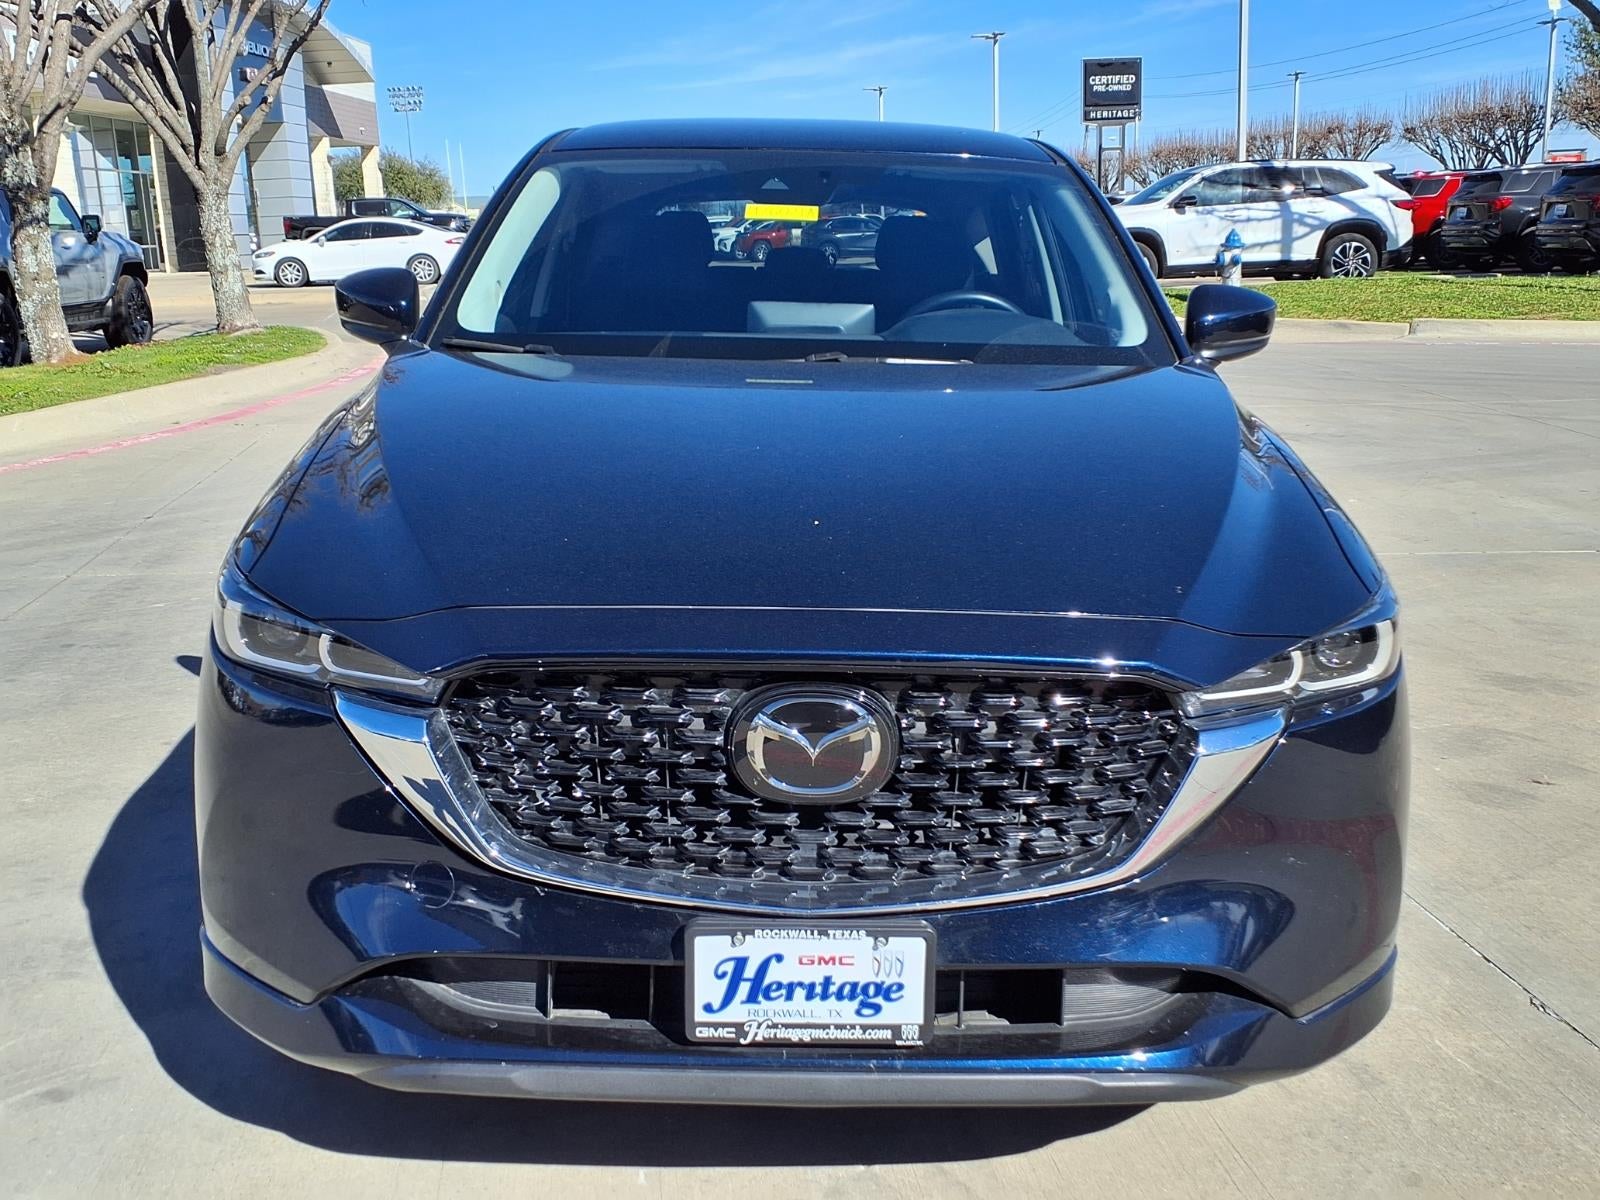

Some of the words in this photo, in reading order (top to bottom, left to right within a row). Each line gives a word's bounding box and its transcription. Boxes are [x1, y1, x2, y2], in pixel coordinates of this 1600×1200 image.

[1089, 74, 1136, 85] CERTIFIED
[1092, 84, 1132, 92] PRE-OWNED
[1090, 109, 1135, 119] HERITAGE
[754, 929, 826, 941] ROCKWALL,
[827, 930, 868, 940] TEXAS
[798, 955, 855, 966] GMC
[702, 953, 905, 1018] Heritage
[827, 1009, 843, 1018] TX
[695, 1027, 736, 1038] GMC
[739, 1019, 892, 1045] Heritagegmcbuick.com
